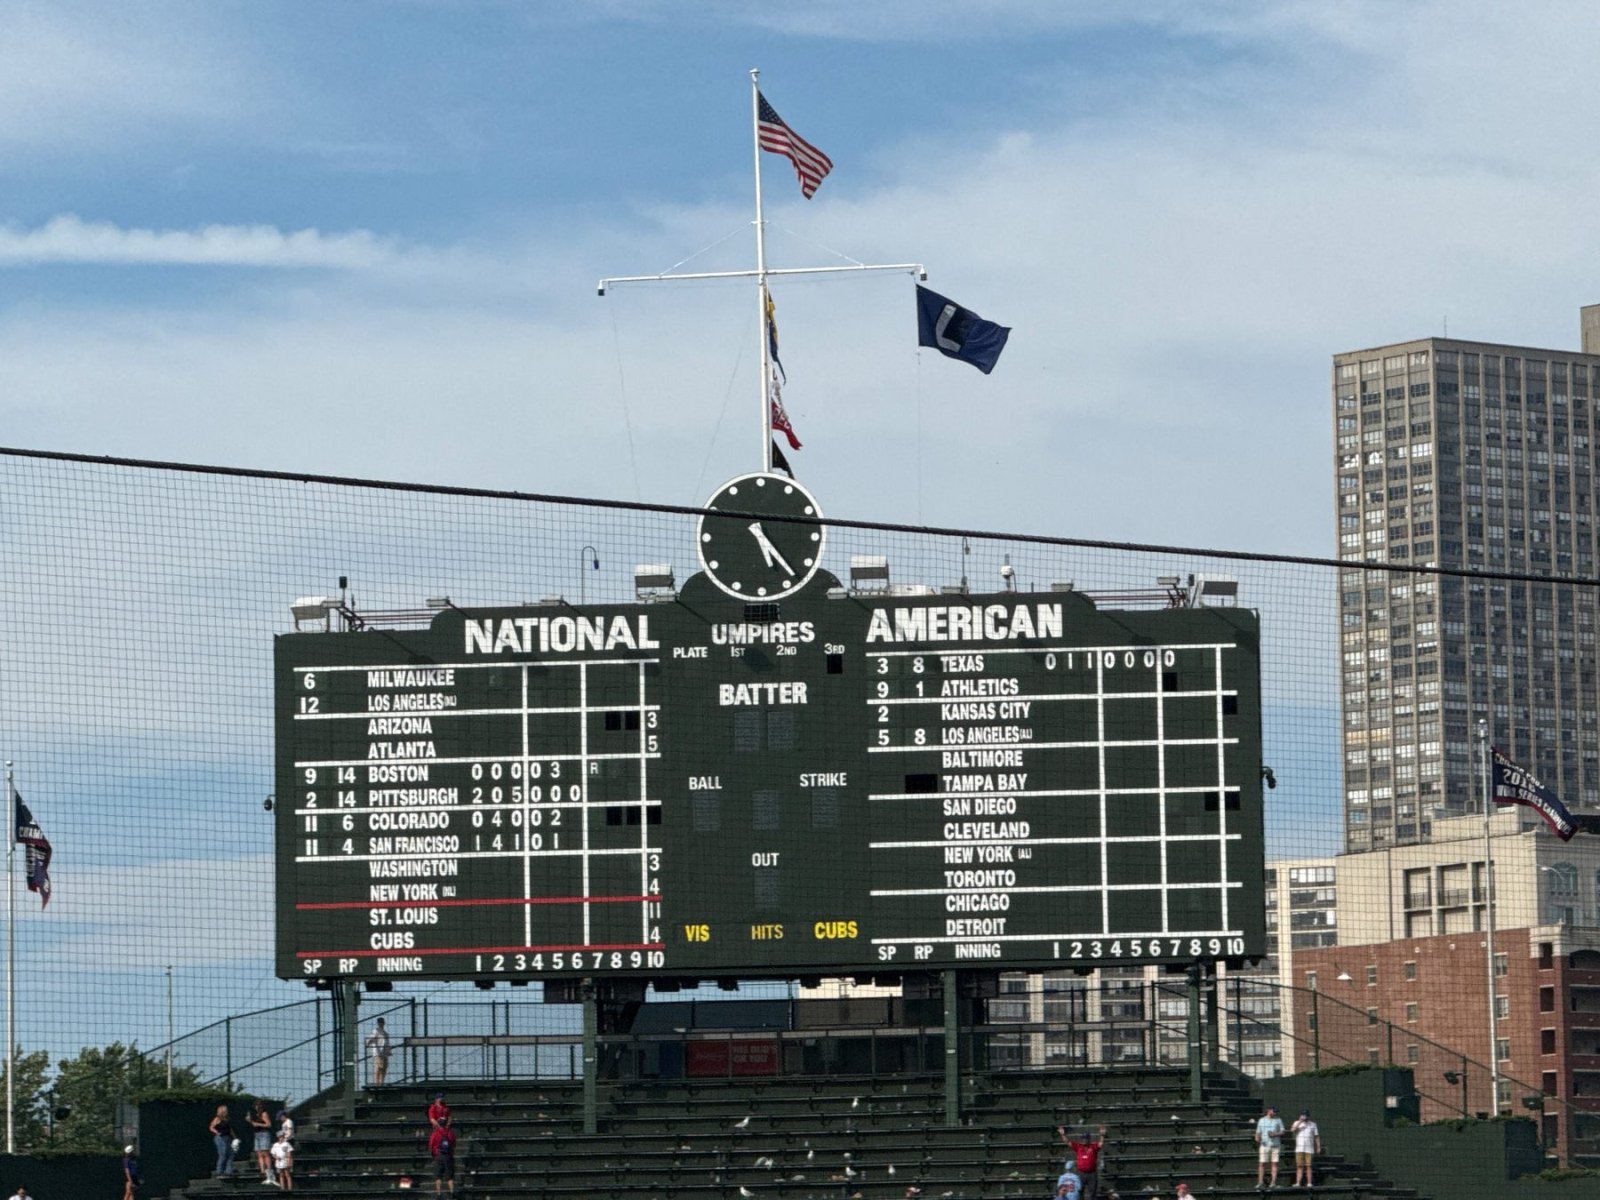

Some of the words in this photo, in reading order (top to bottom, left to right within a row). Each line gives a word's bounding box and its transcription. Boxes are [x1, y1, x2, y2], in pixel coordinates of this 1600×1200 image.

[712, 622, 815, 644] UMPIRES
[866, 604, 1062, 642] AMERICAN
[465, 615, 659, 654] NATIONAL
[673, 647, 708, 658] PLATE
[731, 646, 746, 657] 1ST
[777, 646, 797, 656] 2ND
[824, 644, 845, 654] 3RD
[877, 658, 888, 674] 3
[913, 657, 924, 673] 8
[940, 655, 984, 672] TEXAS
[1045, 654, 1056, 670] 0
[1104, 652, 1115, 668] 0
[1125, 652, 1134, 668] 0
[1144, 651, 1154, 667] 0
[1164, 650, 1174, 667] 0
[304, 673, 315, 689] 6
[368, 670, 454, 687] MILWAUKEE
[877, 681, 888, 698] 9
[916, 681, 923, 697] 1
[941, 678, 1018, 696] ATHLETICS
[720, 682, 807, 705] BATTER
[301, 697, 319, 713] 12
[369, 695, 389, 711] LOS
[878, 706, 888, 722] 2
[942, 703, 995, 720] KANSAS
[1000, 702, 1030, 719] CITY
[368, 718, 432, 735] ARIZONA
[648, 712, 657, 728] 3
[878, 730, 889, 745] 5
[915, 729, 926, 744] 8
[942, 728, 964, 744] LOS
[369, 741, 436, 759] ATLANTA
[648, 735, 658, 751] 5
[942, 751, 1023, 768] BALTIMORE
[305, 768, 317, 784] 9
[338, 768, 356, 783] 14
[369, 765, 428, 782] BOSTON
[472, 764, 482, 780] 0
[491, 763, 502, 779] 0
[511, 763, 522, 779] 0
[531, 762, 541, 778] 0
[551, 762, 560, 778] 3
[590, 762, 598, 774] R
[689, 776, 722, 790] BALL
[800, 773, 847, 787] STRIKE
[943, 775, 994, 791] TAMPA
[998, 774, 1027, 790] BAY
[306, 792, 317, 807] 2
[339, 791, 356, 807] 14
[369, 788, 458, 806] PITTSBURGH
[473, 788, 482, 804] 2
[492, 787, 502, 803] 0
[512, 786, 522, 803] 5
[531, 786, 541, 802] 0
[551, 785, 561, 802] 0
[570, 785, 580, 801] 0
[944, 799, 970, 816] SAN
[975, 798, 1016, 815] DIEGO
[343, 815, 353, 830] 6
[369, 812, 449, 830] COLORADO
[472, 811, 483, 827] 0
[492, 810, 502, 826] 4
[512, 810, 522, 826] 0
[531, 810, 542, 826] 0
[551, 809, 561, 825] 2
[944, 822, 1030, 839] CLEVELAND
[343, 839, 354, 854] 4
[370, 838, 391, 854] SAN
[395, 835, 459, 853] FRANCISCO
[492, 834, 502, 850] 4
[532, 833, 542, 849] 0
[752, 853, 779, 867] OUT
[945, 847, 973, 863] NEW
[977, 846, 1013, 862] YORK
[370, 859, 457, 877] WASHINGTON
[650, 854, 660, 871] 3
[944, 870, 1016, 887] TORONTO
[370, 885, 399, 901] NEW
[402, 884, 438, 900] YORK
[650, 878, 660, 894] 4
[946, 894, 1009, 911] CHICAGO
[370, 908, 392, 925] ST.
[396, 907, 438, 924] LOUIS
[685, 925, 710, 942] VIS
[752, 924, 783, 940] HITS
[814, 921, 858, 939] CUBS
[946, 918, 1006, 935] DETROIT
[371, 932, 414, 949] CUBS
[650, 926, 660, 943] 4
[878, 946, 896, 960] SP
[914, 945, 933, 959] RP
[956, 944, 1001, 958] INNING
[1071, 942, 1082, 958] 2
[1091, 941, 1102, 957] 3
[1111, 941, 1122, 957] 4
[1131, 940, 1142, 956] 5
[1150, 940, 1160, 956] 6
[1170, 940, 1181, 956] 7
[1190, 939, 1201, 955] 8
[1209, 939, 1220, 955] 9
[1228, 938, 1244, 955] 10
[304, 960, 321, 974] SP
[339, 959, 358, 973] RP
[377, 958, 422, 972] INNING
[493, 955, 504, 971] 2
[515, 954, 526, 970] 3
[532, 954, 544, 970] 4
[552, 953, 563, 969] 5
[572, 953, 583, 969] 6
[592, 953, 602, 968] 7
[611, 952, 622, 968] 8
[631, 952, 642, 968] 9
[648, 952, 664, 968] 10
